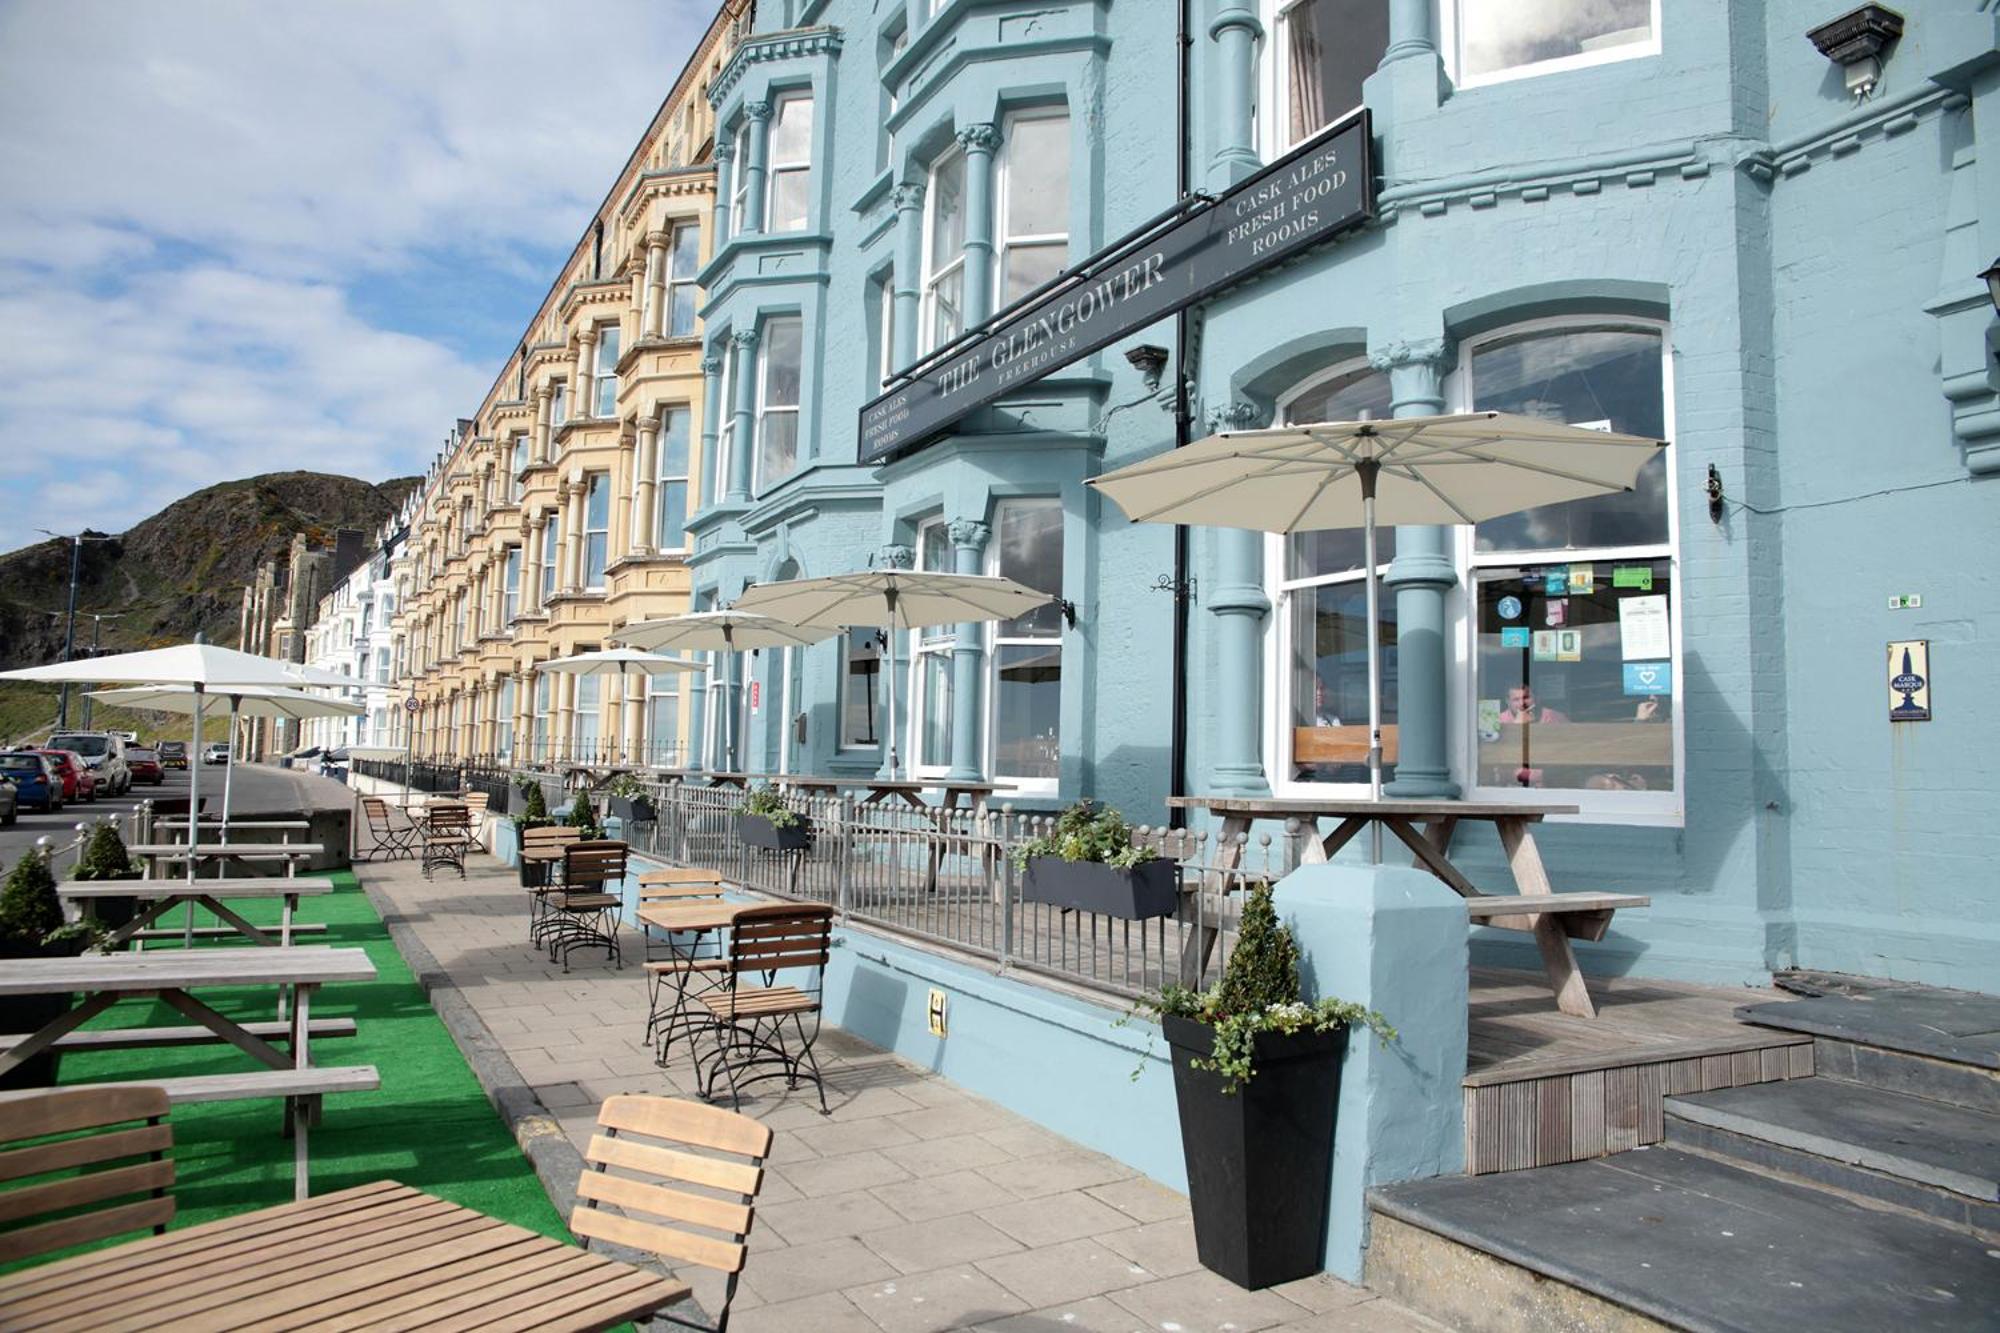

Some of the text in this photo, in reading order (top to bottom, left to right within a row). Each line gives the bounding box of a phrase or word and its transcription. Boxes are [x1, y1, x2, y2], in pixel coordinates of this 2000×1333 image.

[1227, 169, 1347, 246] FRESH FOOD
[1235, 150, 1337, 217] CASK ALES
[1251, 210, 1319, 256] ROOMS
[938, 252, 1166, 400] THE GLENGOWER
[998, 336, 1077, 386] FREEHOUSE
[408, 700, 418, 708] 20
